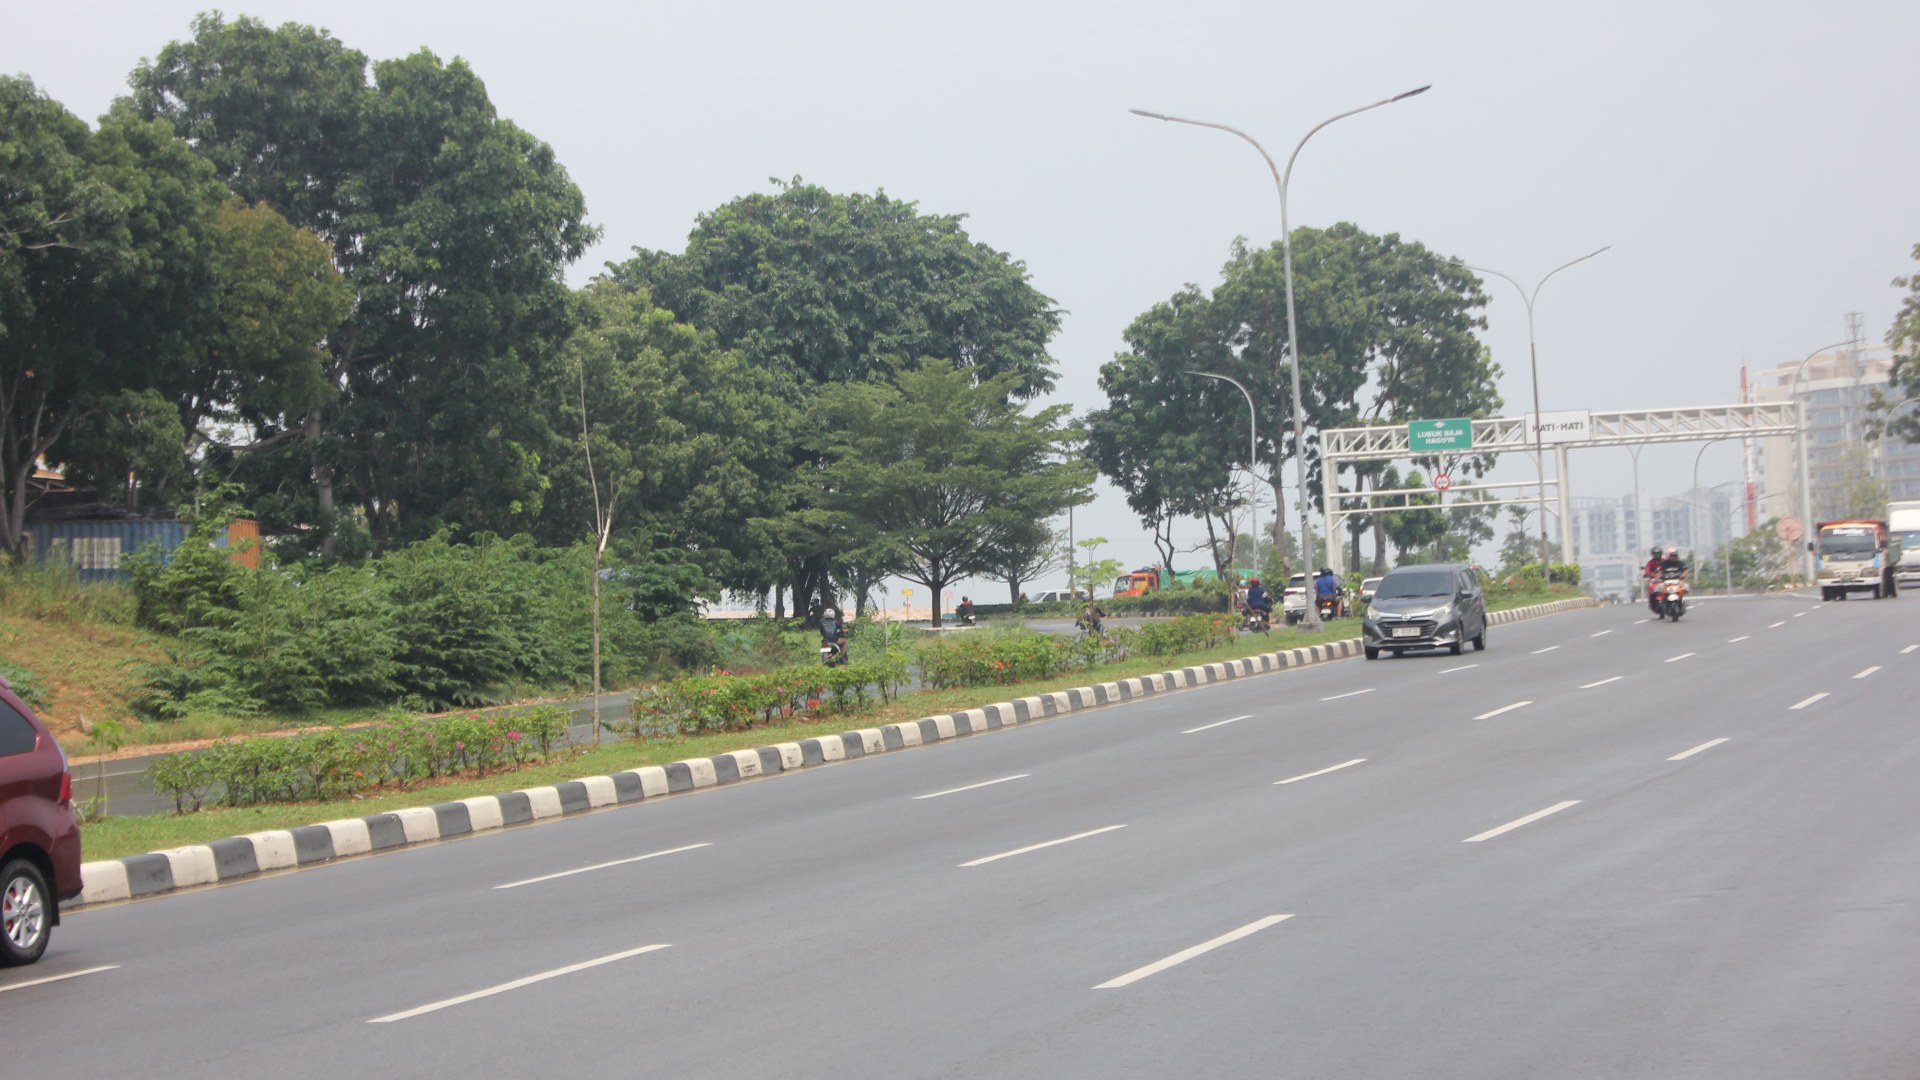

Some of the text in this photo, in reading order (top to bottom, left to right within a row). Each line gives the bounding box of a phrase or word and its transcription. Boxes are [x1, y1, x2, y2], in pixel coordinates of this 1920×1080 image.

[1417, 429, 1464, 438] LUBUK BAJA
[1425, 436, 1456, 445] NAGOYA
